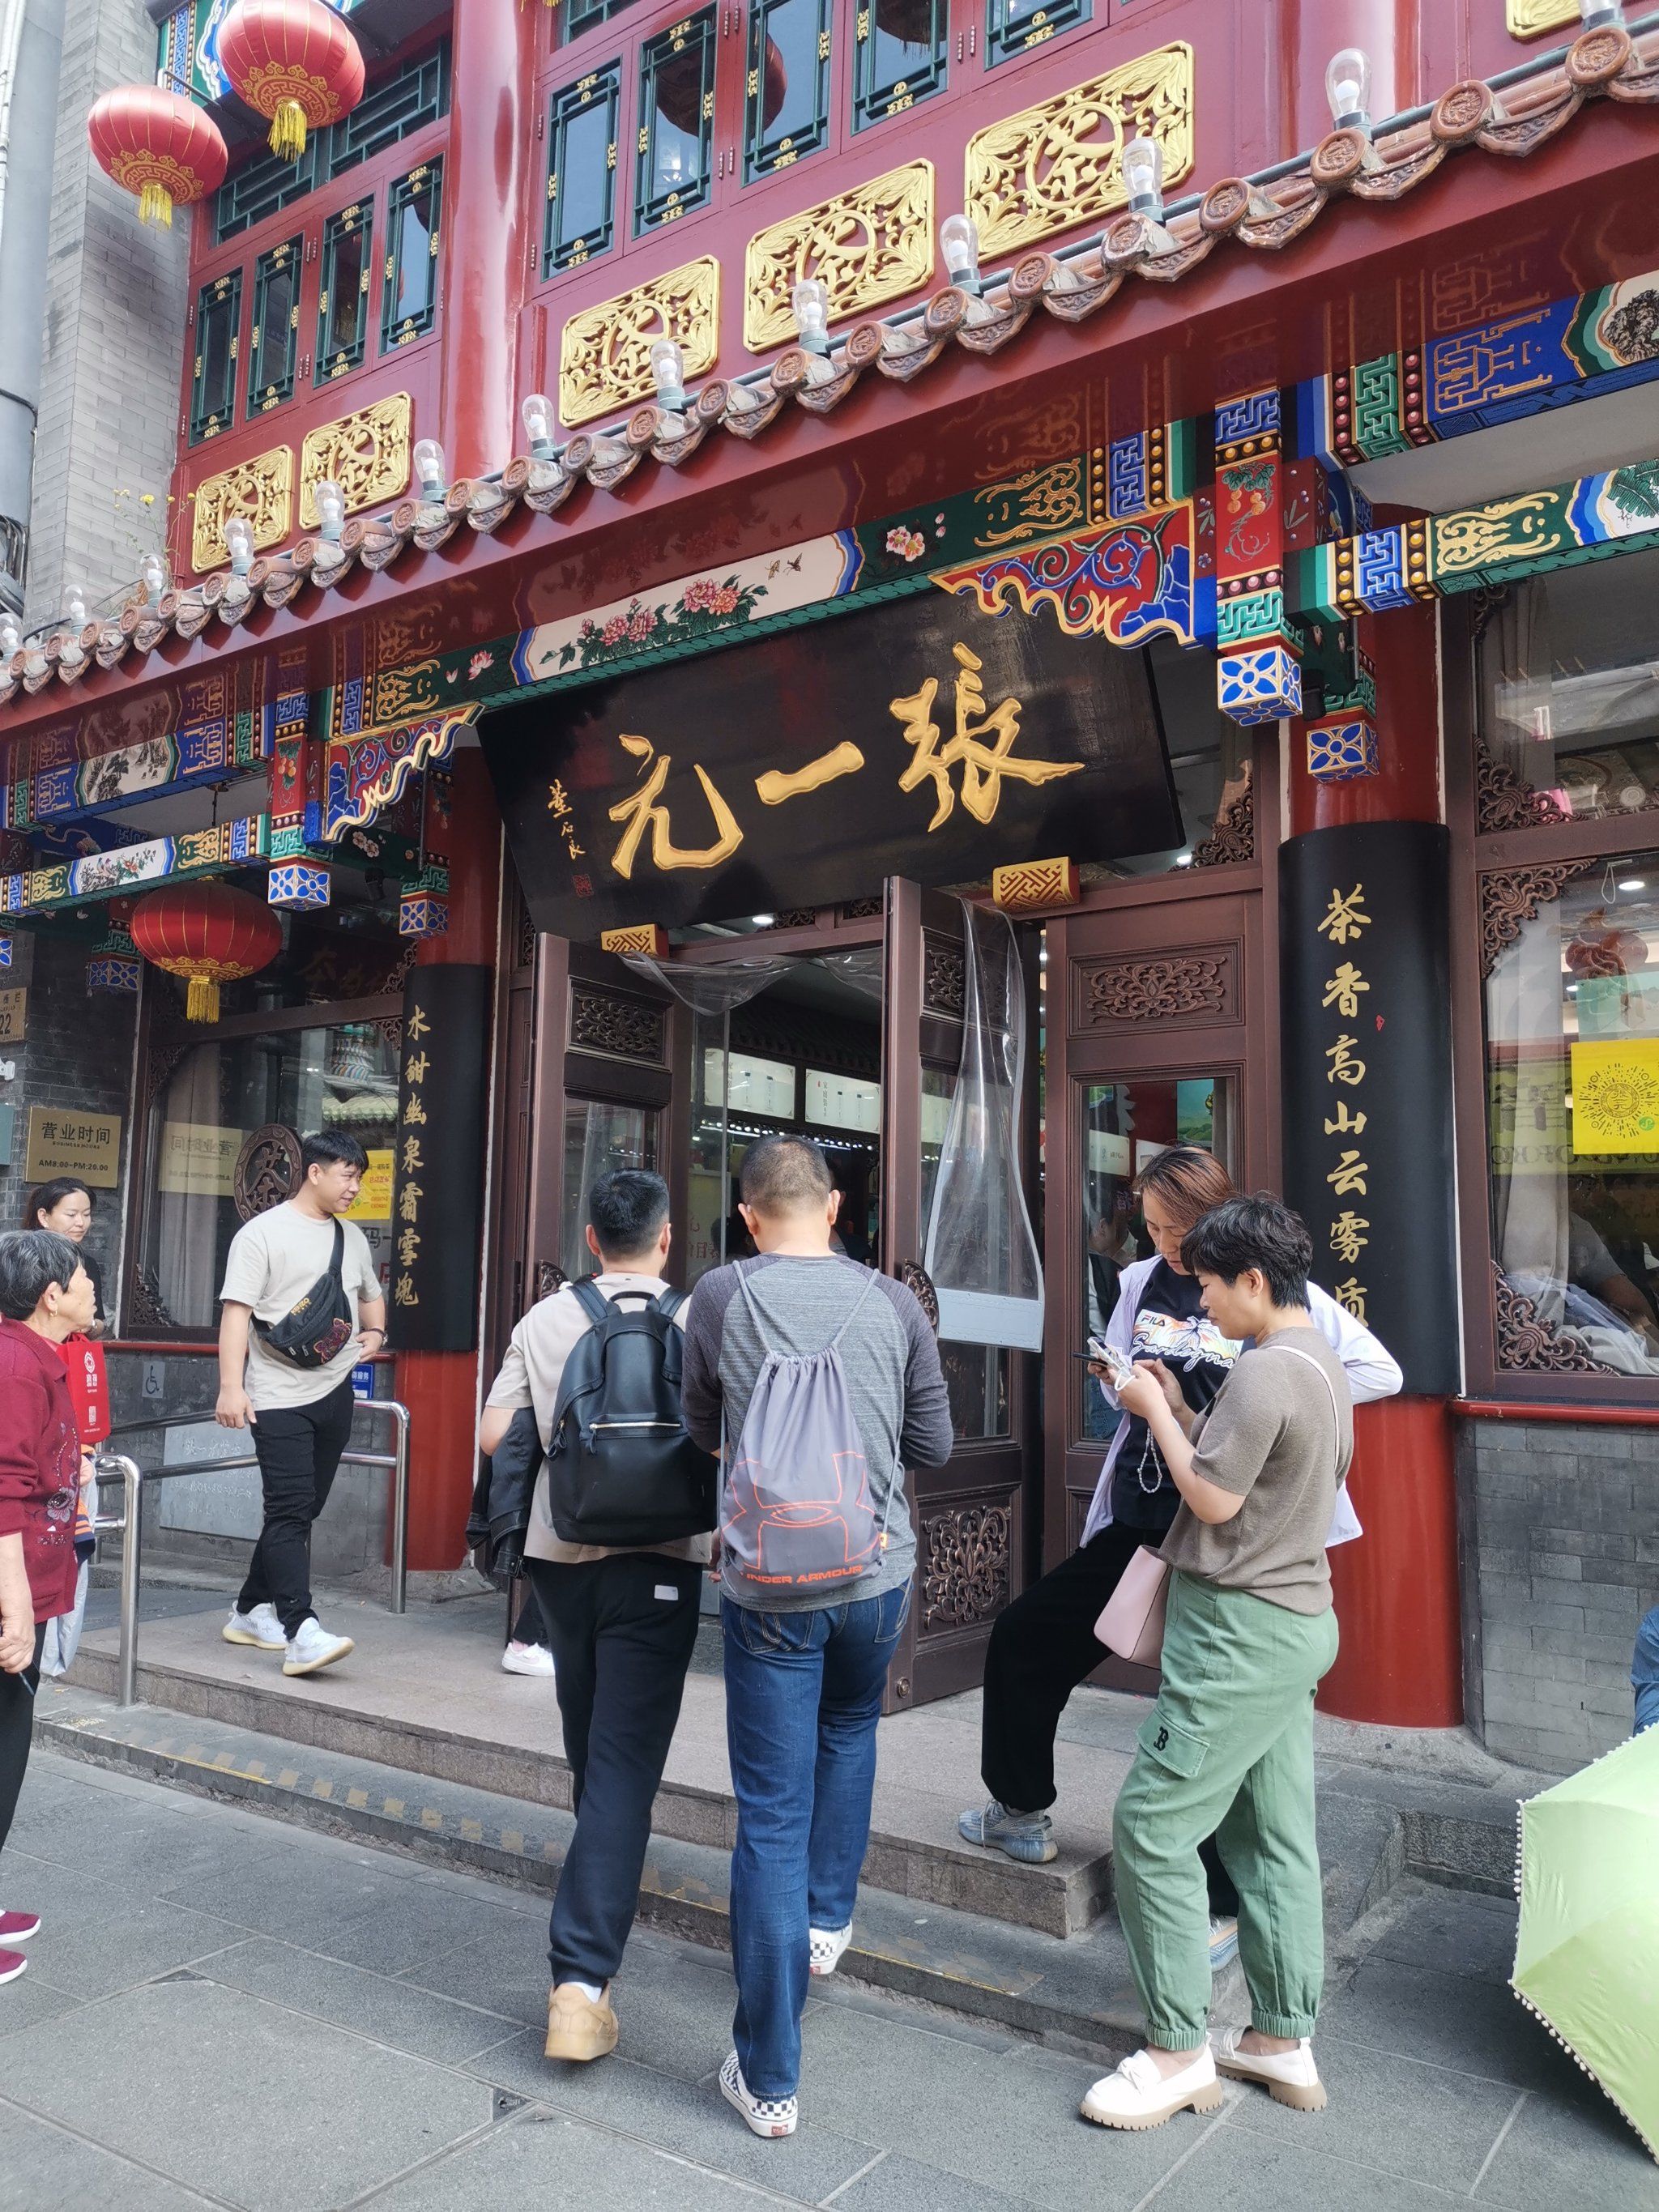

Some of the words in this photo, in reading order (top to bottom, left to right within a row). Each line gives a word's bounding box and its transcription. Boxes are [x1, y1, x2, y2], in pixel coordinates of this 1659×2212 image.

[41, 1122, 110, 1144] 营业时间
[1141, 1314, 1166, 1327] FILA
[796, 1564, 864, 1583] ARMOUR
